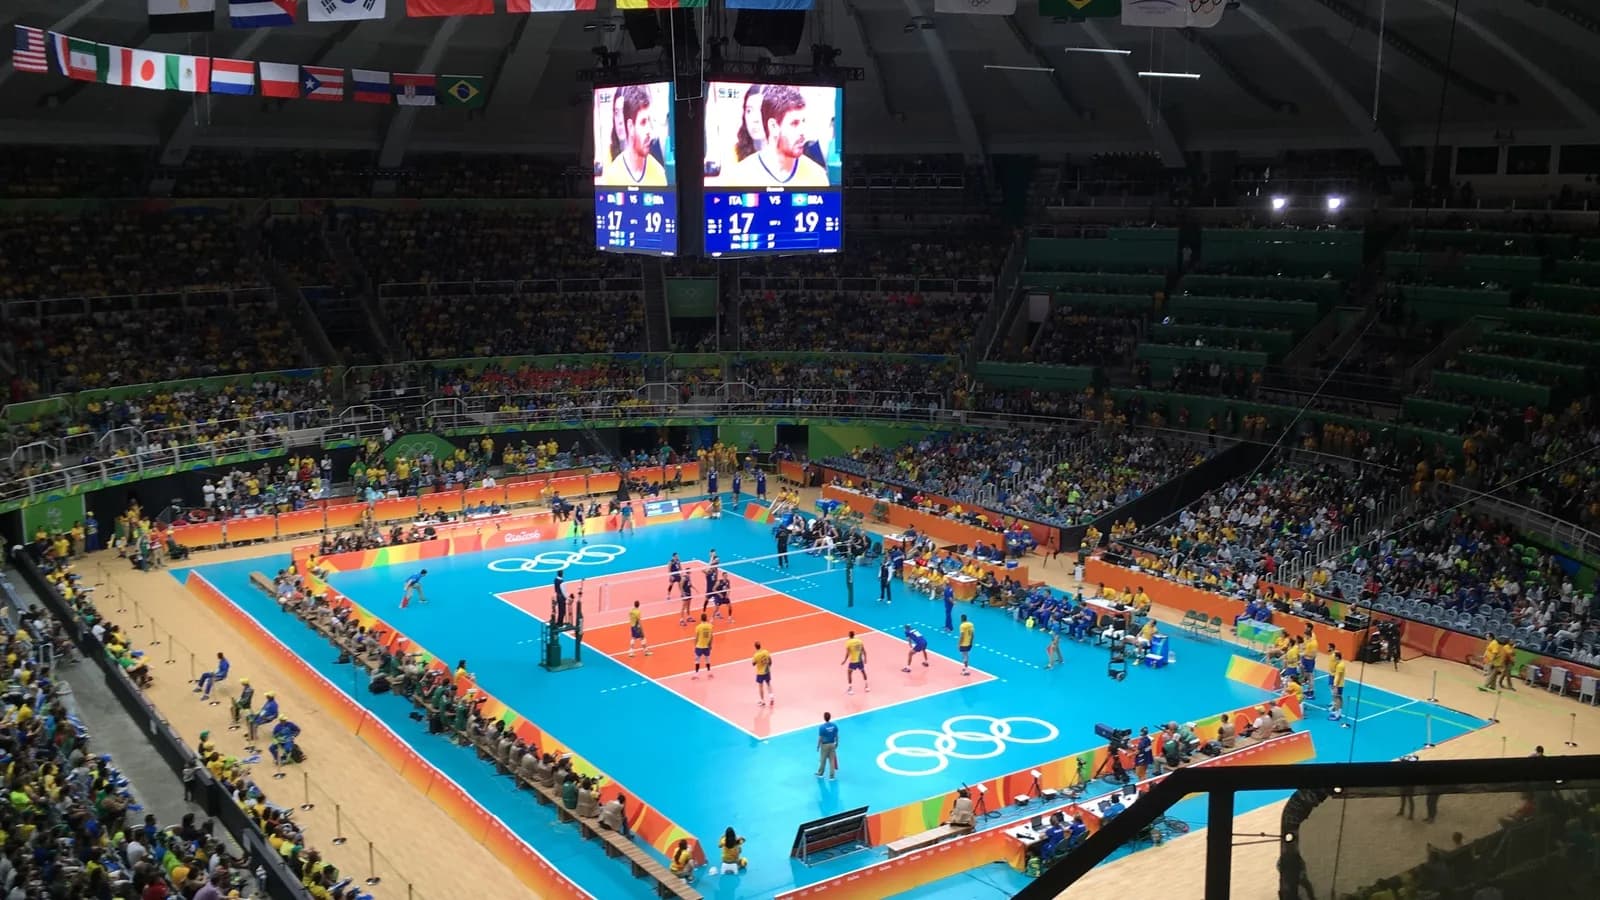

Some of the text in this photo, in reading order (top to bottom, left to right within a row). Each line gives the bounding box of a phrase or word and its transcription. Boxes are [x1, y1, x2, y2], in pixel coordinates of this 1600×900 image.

[607, 211, 623, 231] 17
[645, 212, 662, 233] 19
[729, 213, 755, 234] 17
[794, 211, 819, 233] 19
